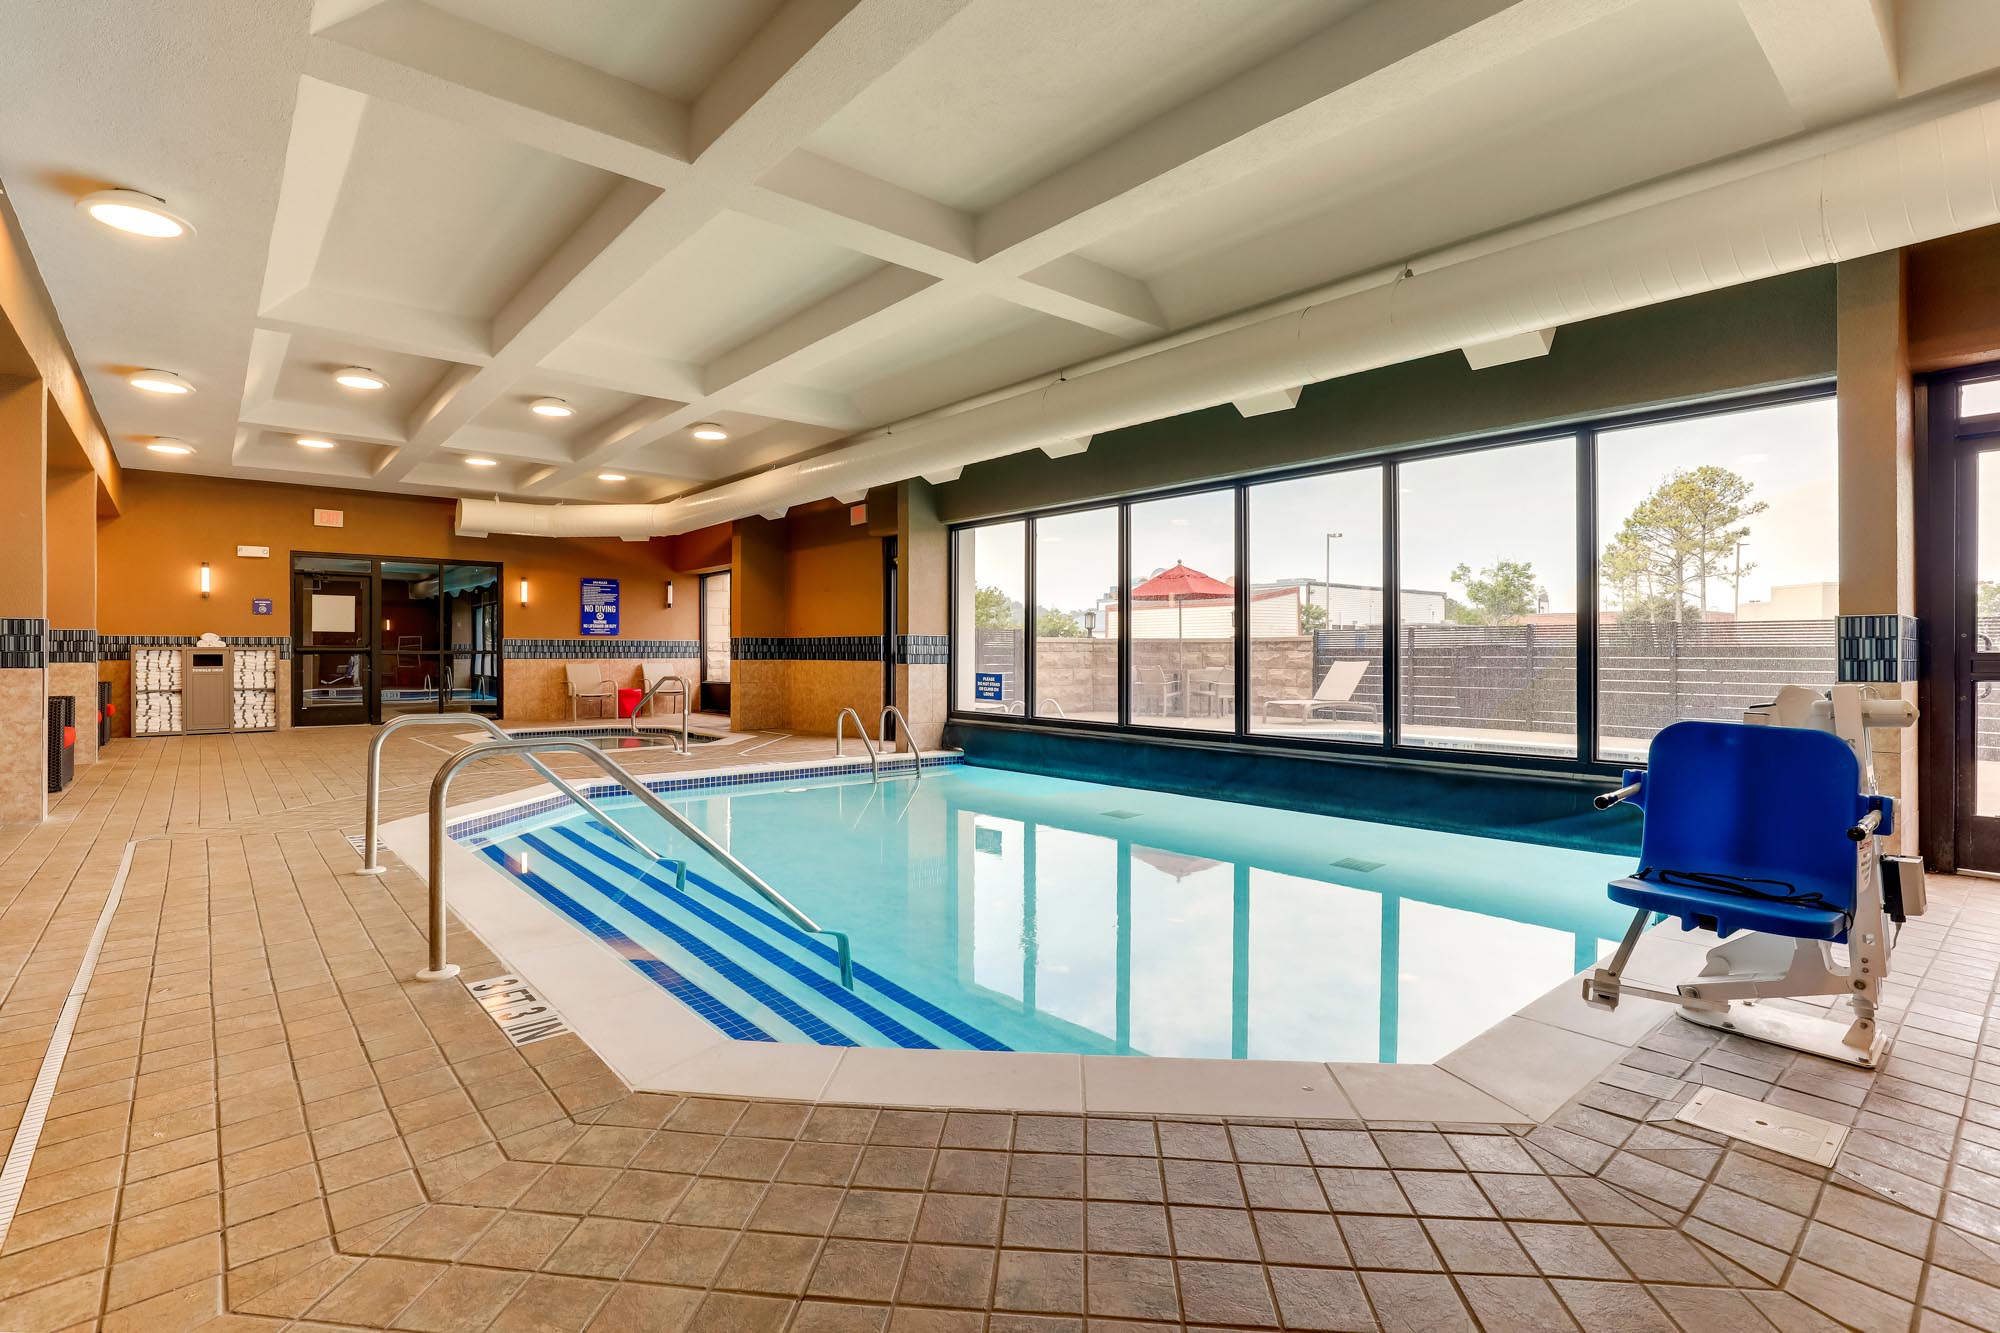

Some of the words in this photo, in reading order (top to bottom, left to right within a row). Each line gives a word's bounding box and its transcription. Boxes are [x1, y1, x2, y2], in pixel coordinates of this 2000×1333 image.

[584, 604, 593, 612] NO
[595, 605, 616, 613] DIVING
[473, 979, 518, 991] 3
[481, 988, 536, 1009] FT
[500, 1006, 547, 1020] 3
[508, 1017, 568, 1043] IN
